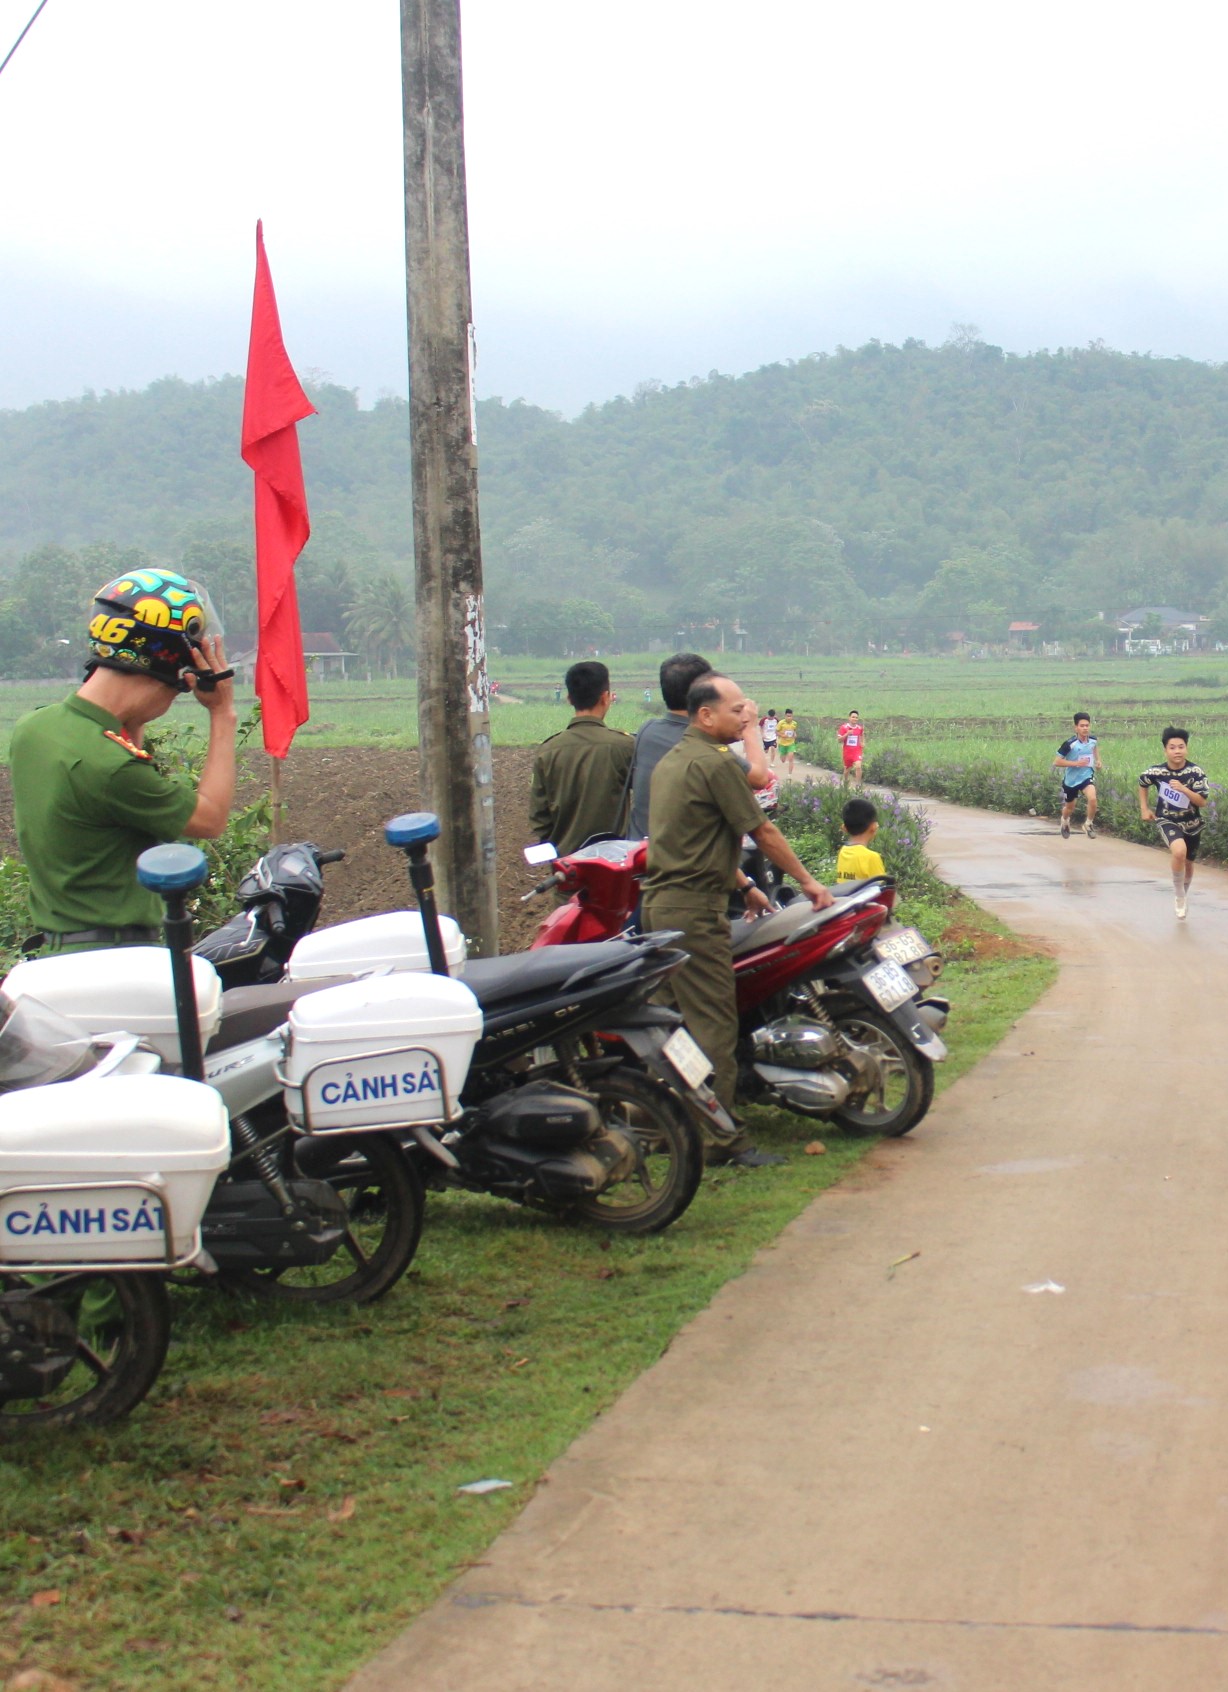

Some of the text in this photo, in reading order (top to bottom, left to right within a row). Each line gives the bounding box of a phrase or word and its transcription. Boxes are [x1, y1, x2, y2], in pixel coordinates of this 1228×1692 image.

[89, 613, 135, 644] 46
[1164, 788, 1180, 802] 050
[321, 1073, 398, 1104] CẢNH
[6, 1202, 106, 1235] CẢNH
